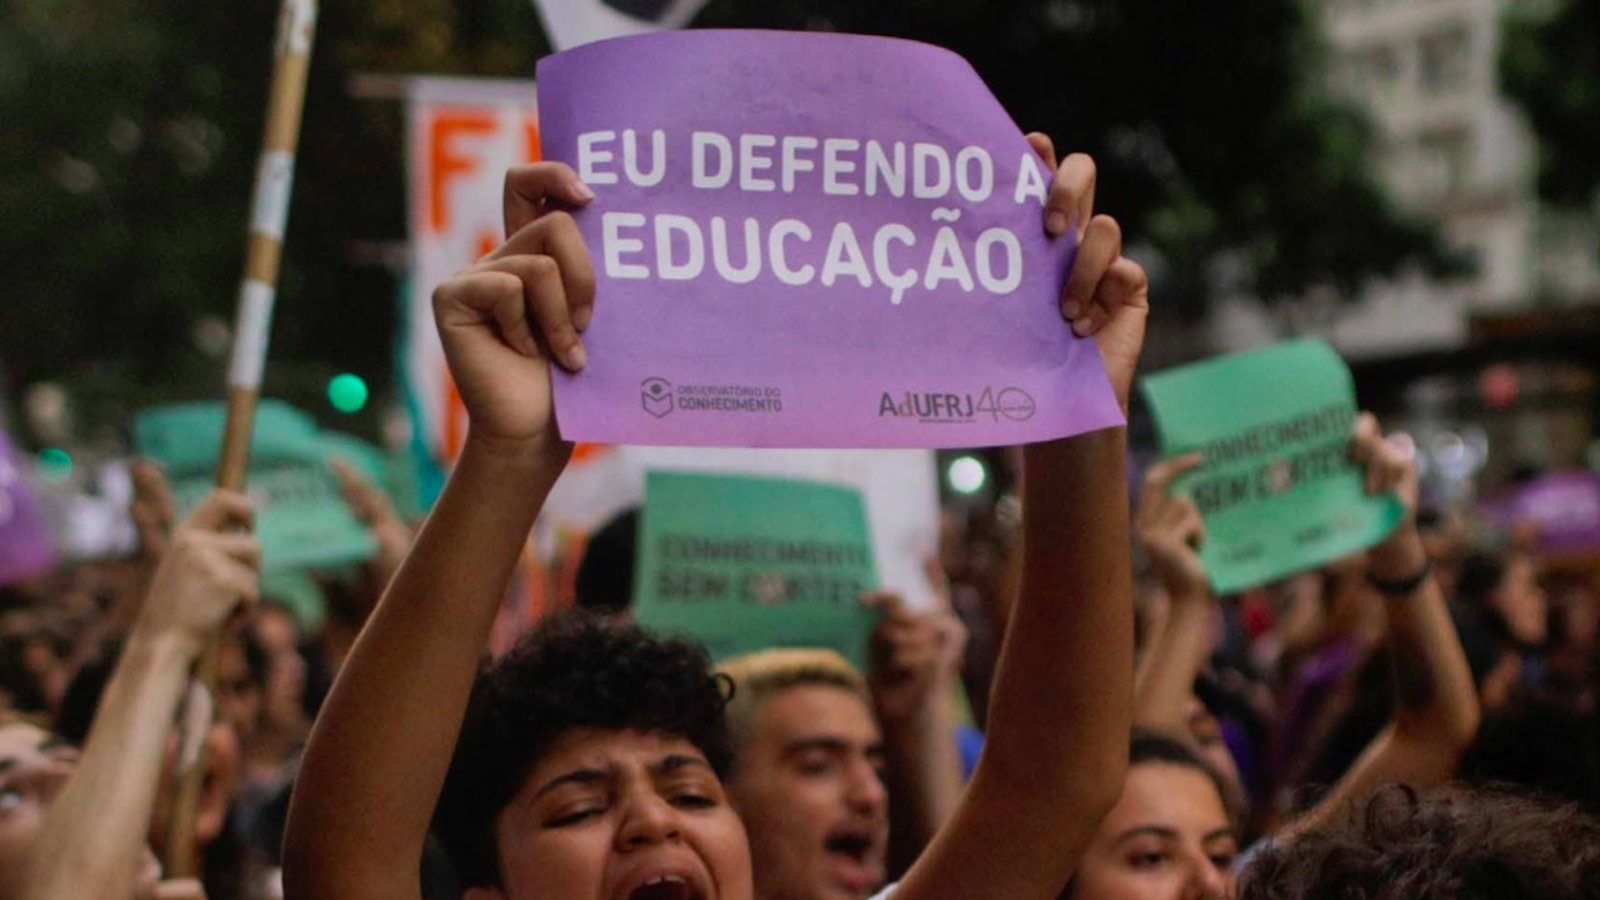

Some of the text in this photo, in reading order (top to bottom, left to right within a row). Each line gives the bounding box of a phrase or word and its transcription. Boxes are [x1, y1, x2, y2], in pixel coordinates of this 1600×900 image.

[577, 129, 1049, 205] EU DEFENDO A
[602, 207, 1023, 304] EDUCAÇÃO
[677, 384, 781, 398] OBSERVATÓRIO DO
[878, 391, 974, 417] AdUFRJ
[678, 397, 782, 412] CONHECIMENTO
